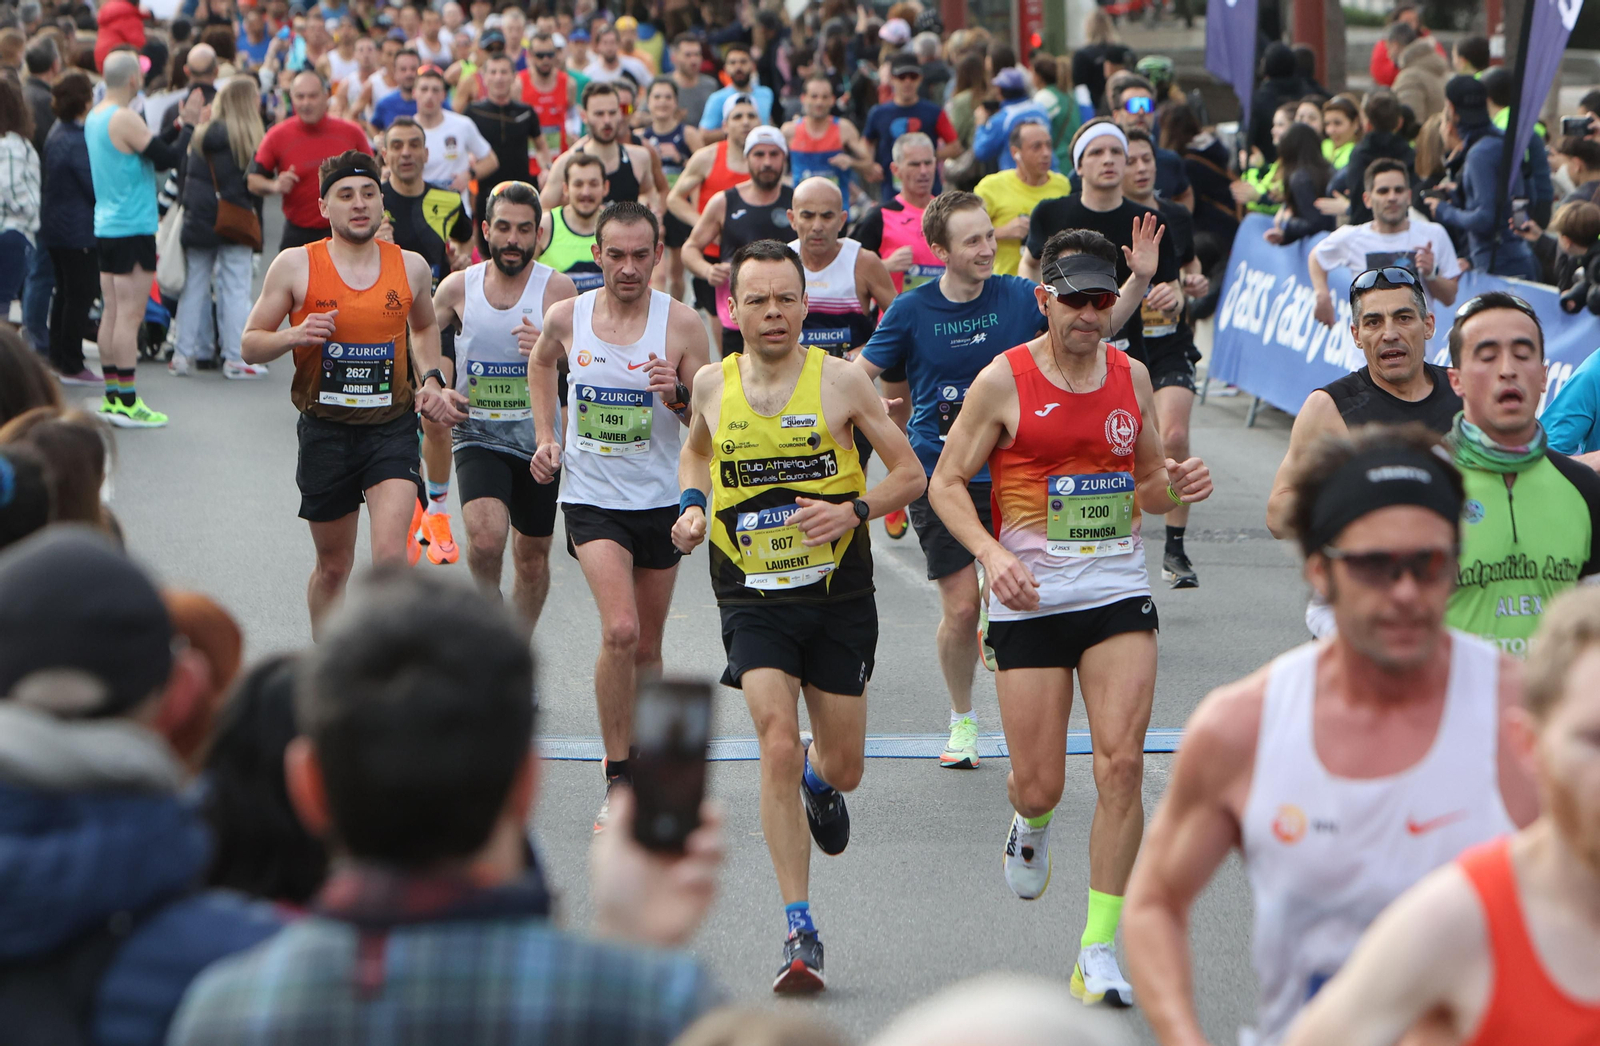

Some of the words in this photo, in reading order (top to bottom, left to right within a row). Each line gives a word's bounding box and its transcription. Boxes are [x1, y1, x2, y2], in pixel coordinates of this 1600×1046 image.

[934, 313, 999, 336] FINISHER
[808, 331, 844, 341] ZURICH
[348, 346, 387, 356] ZURICH
[346, 367, 371, 378] 2627
[488, 366, 525, 374] ZURICH
[342, 384, 373, 393] ADRIEN
[488, 384, 511, 394] 1112
[476, 398, 501, 407] VICTOR
[600, 392, 643, 402] ZURICH
[600, 413, 623, 425] 1491
[787, 418, 816, 426] quevilly
[598, 431, 626, 441] JAVIER
[740, 462, 763, 472] Club
[820, 453, 837, 476] 76
[742, 474, 777, 485] Quevillais
[779, 471, 821, 480] Couronnais
[1081, 477, 1126, 490] ZURICH
[1080, 505, 1109, 518] 1200
[1070, 526, 1116, 538] ESPINOSA
[771, 536, 793, 551] 807
[765, 555, 809, 570] LAURENT
[1496, 596, 1543, 617] ALEX
